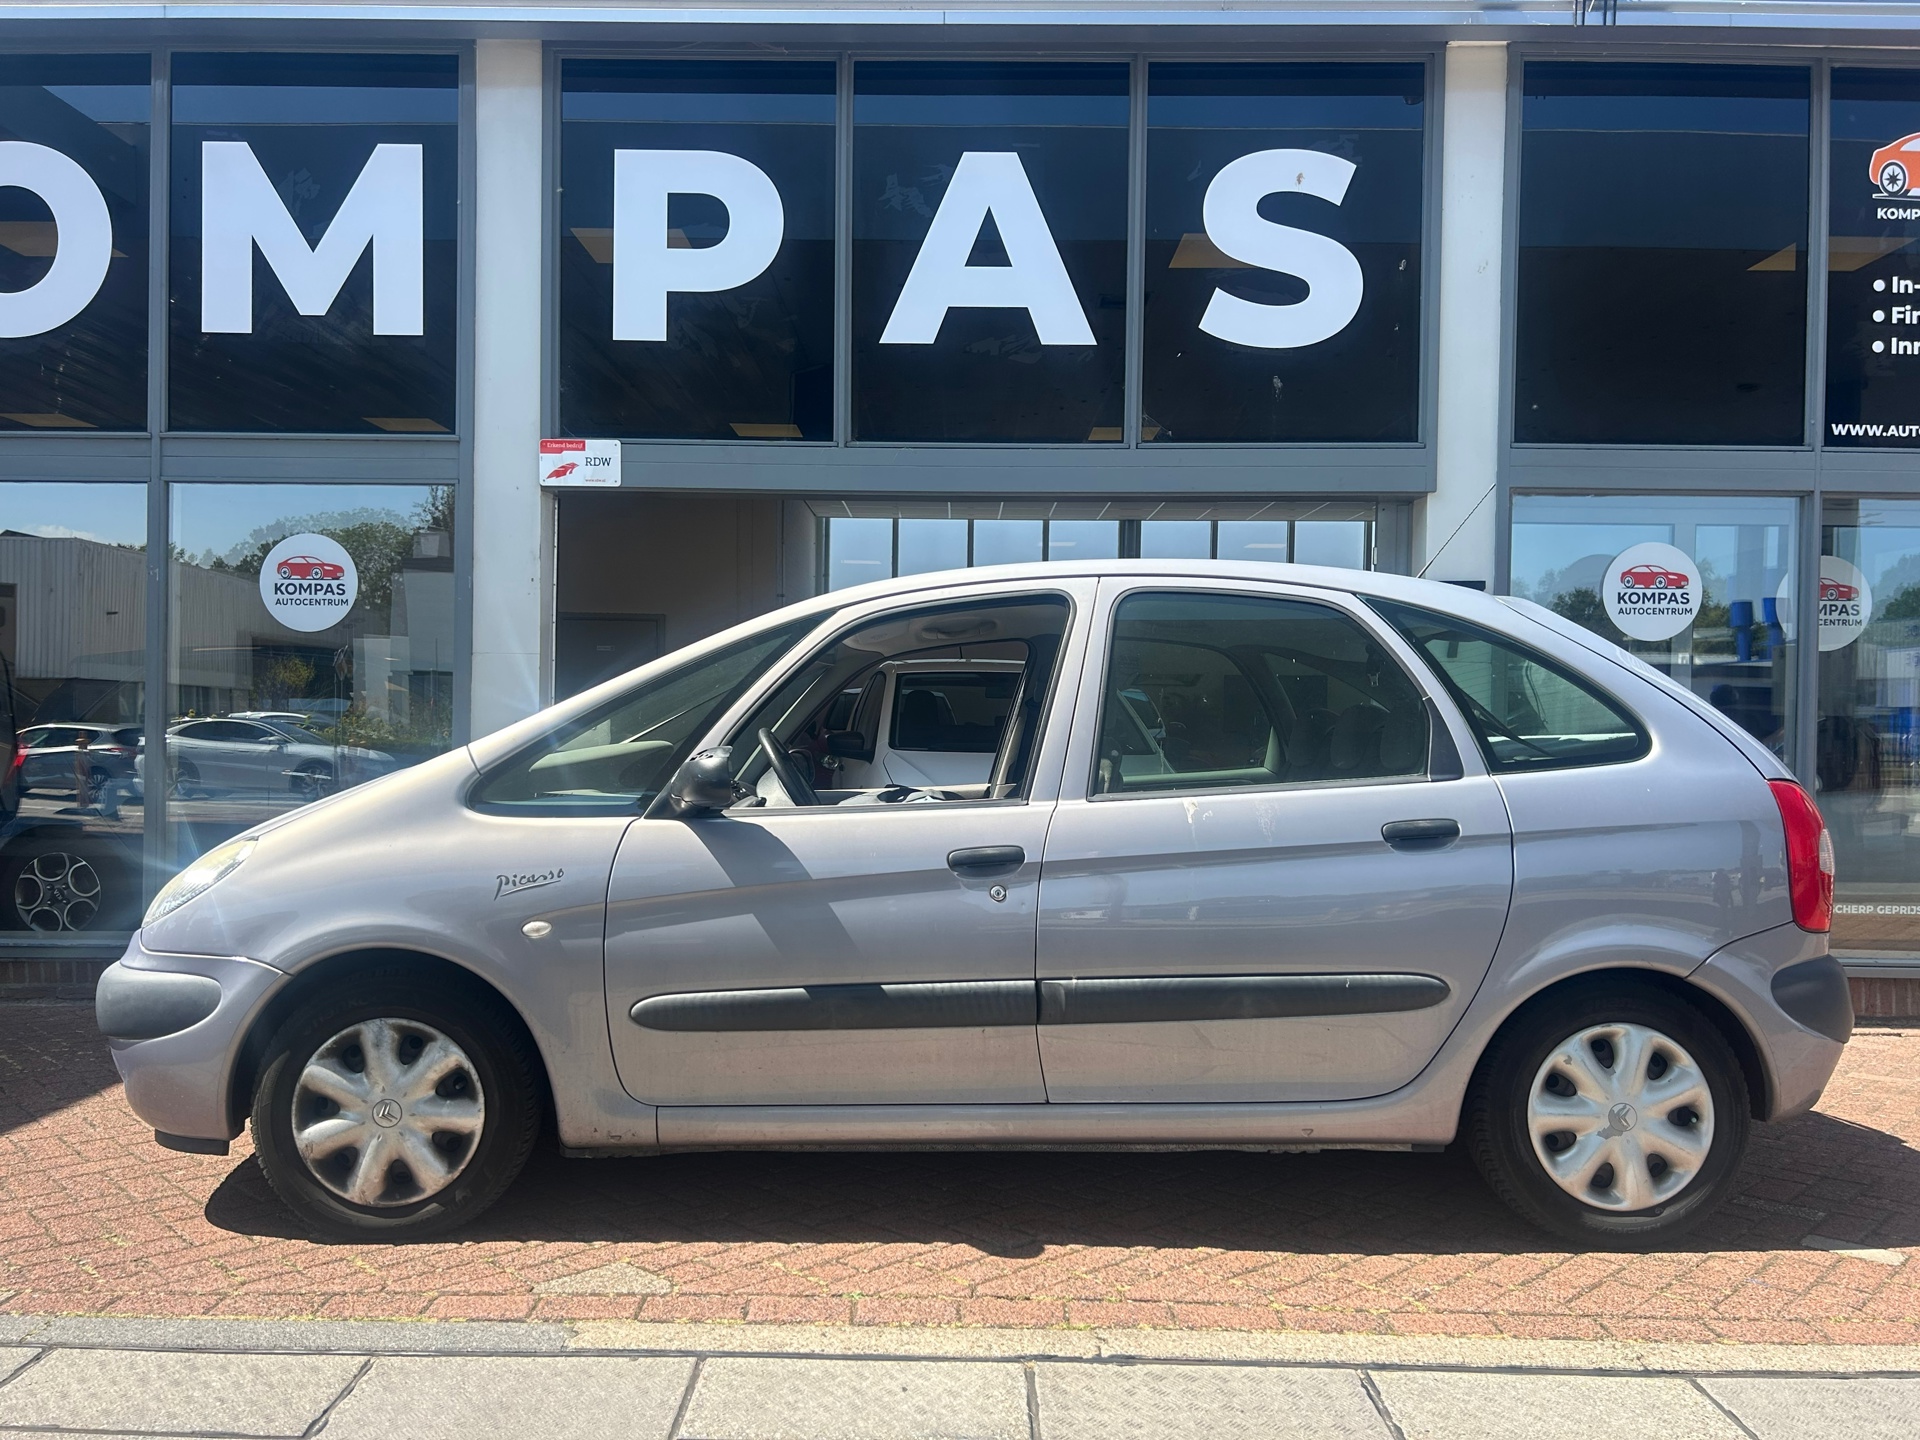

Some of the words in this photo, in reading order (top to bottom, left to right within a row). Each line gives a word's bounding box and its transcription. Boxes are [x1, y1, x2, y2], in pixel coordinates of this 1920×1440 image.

[1876, 207, 1920, 220] KOMP
[1892, 276, 1920, 294] In-
[1831, 423, 1920, 437] WWW.AUT
[585, 456, 612, 467] RDW
[274, 582, 346, 596] KOMPAS
[275, 598, 349, 606] AUTOCENTRUM
[1617, 591, 1690, 605] KOMPAS
[1618, 607, 1693, 616] AUTOCENTRUM
[494, 867, 565, 901] Picasso
[1833, 904, 1874, 914] CHERP
